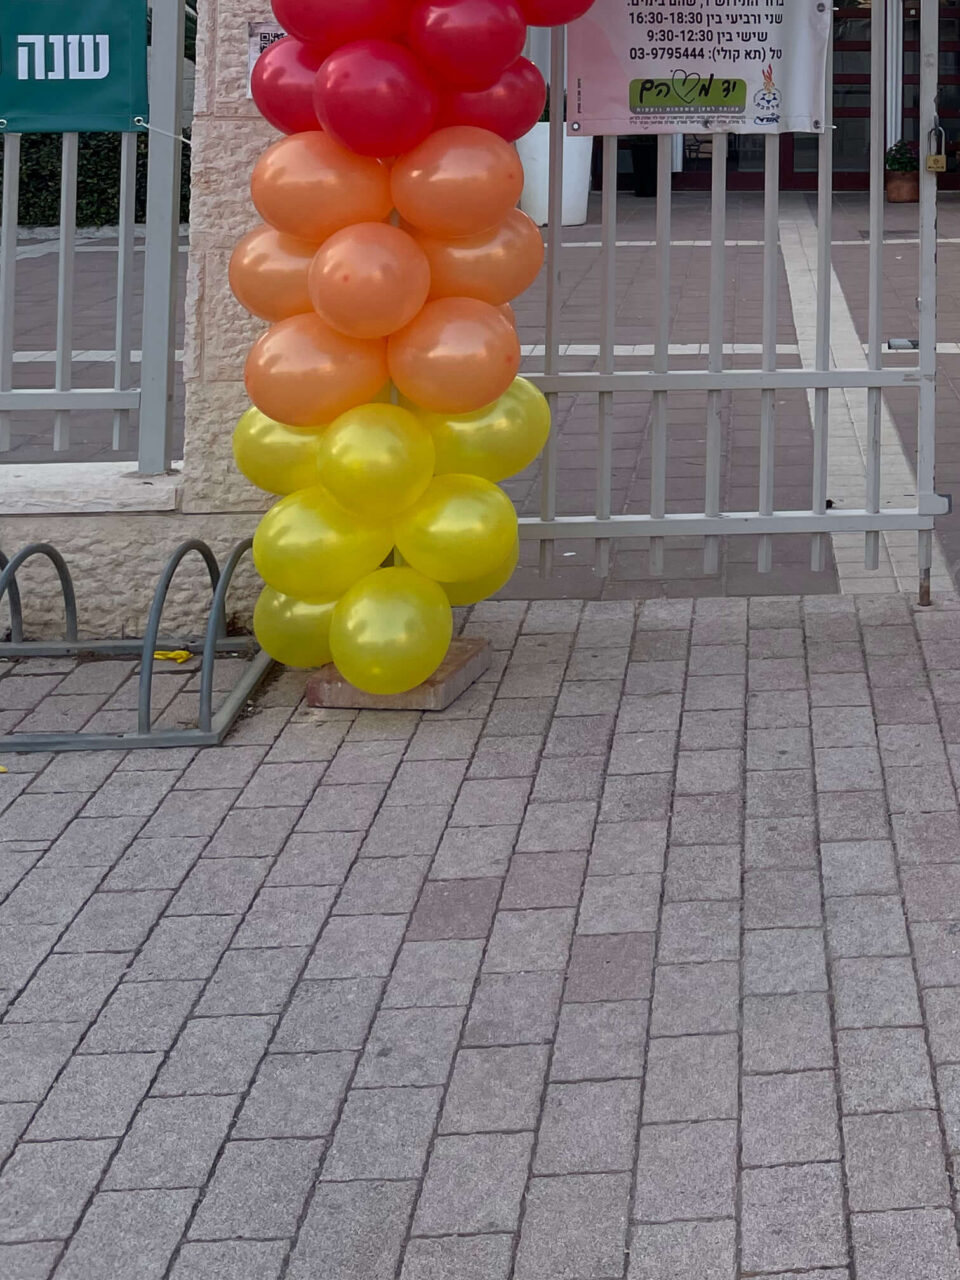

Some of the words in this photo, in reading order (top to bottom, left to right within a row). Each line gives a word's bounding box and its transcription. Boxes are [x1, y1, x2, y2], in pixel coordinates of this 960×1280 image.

[629, 12, 703, 24] 16:30-18:30
[706, 13, 722, 27] בין
[725, 13, 761, 24] ורביעי
[764, 13, 783, 24] שני
[647, 29, 713, 42] 9:30-12:30
[717, 31, 733, 44] בין
[736, 31, 768, 42] שישי
[17, 35, 110, 80] שנה
[630, 47, 704, 60] 03-9795444
[769, 47, 782, 59] טל
